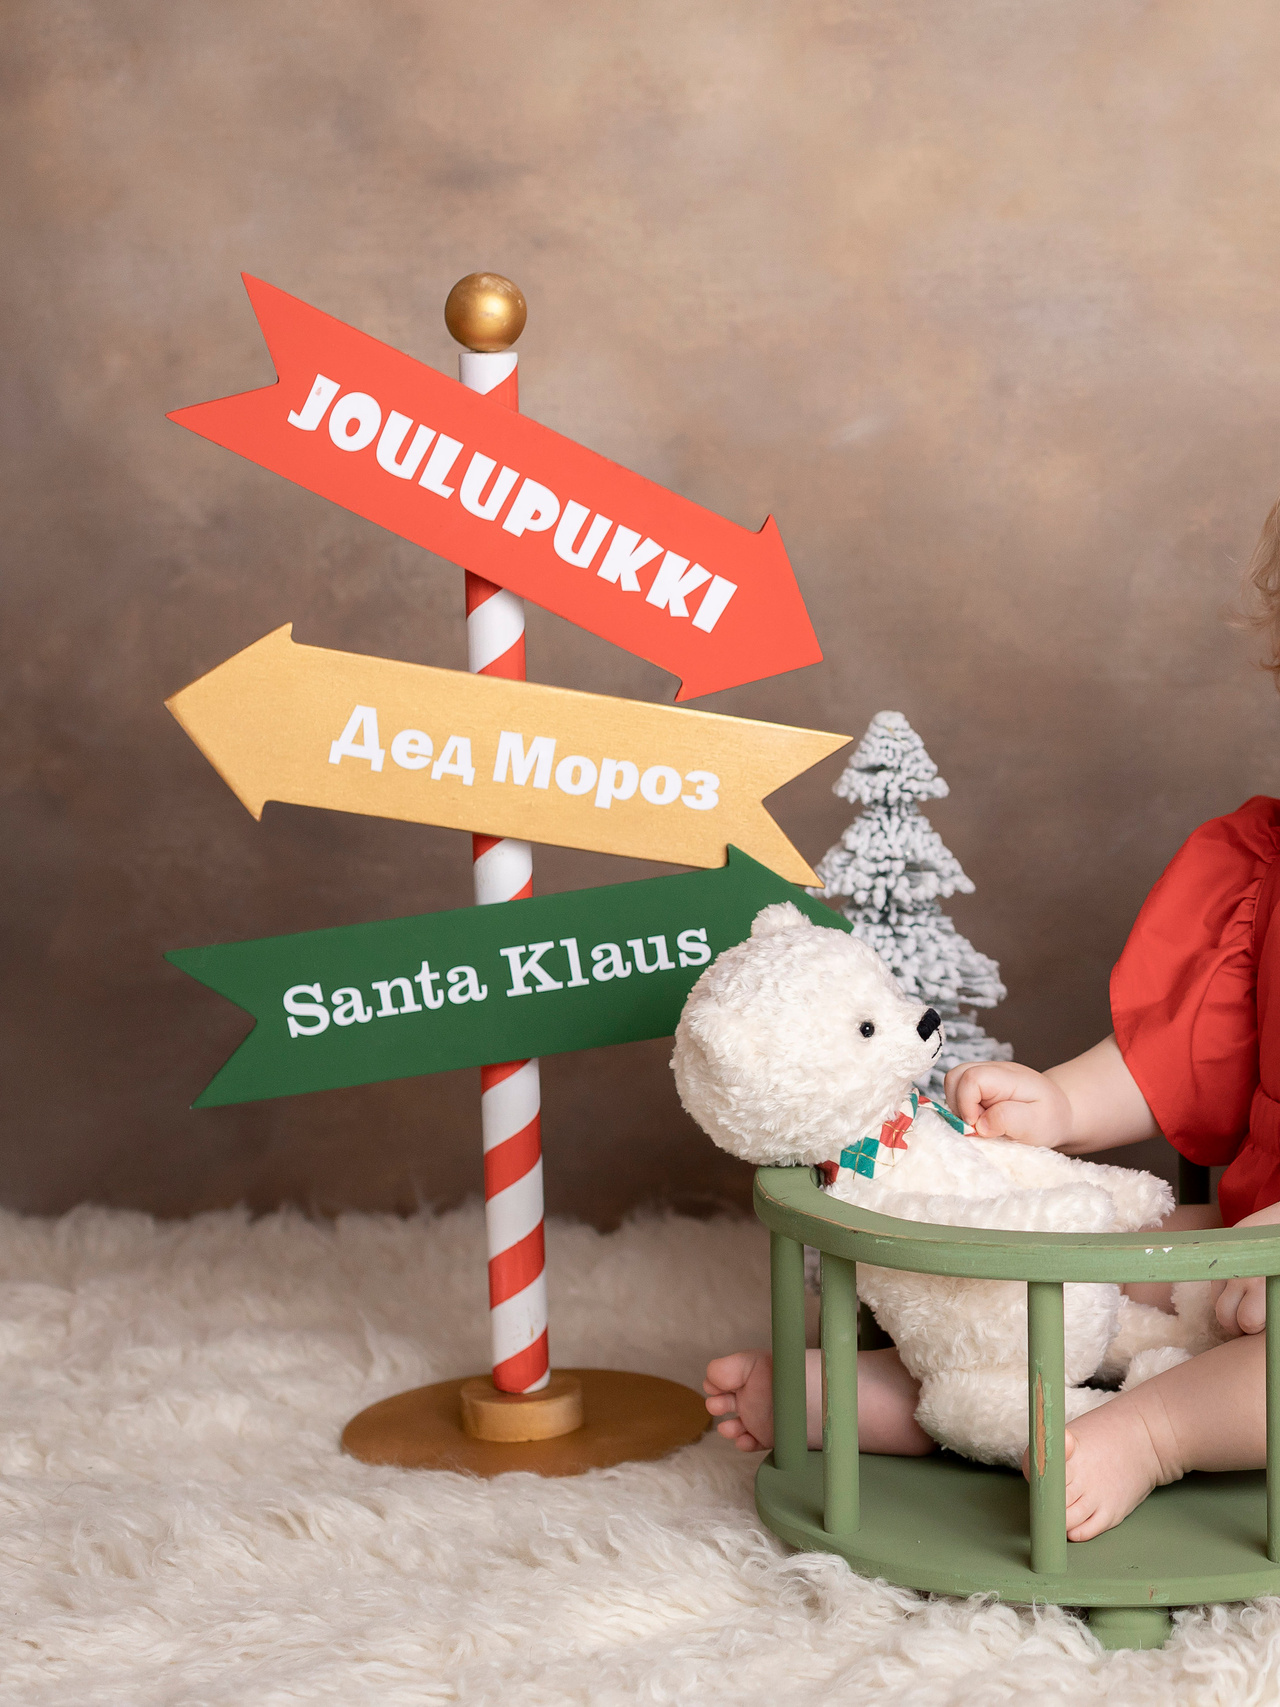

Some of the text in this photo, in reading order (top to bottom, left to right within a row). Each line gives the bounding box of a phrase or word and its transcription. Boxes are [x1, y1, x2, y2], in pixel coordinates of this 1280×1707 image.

[286, 372, 738, 634] JOULUPUKKI
[327, 704, 721, 810] Дед Мороз
[282, 926, 713, 1039] Santa Klaus
